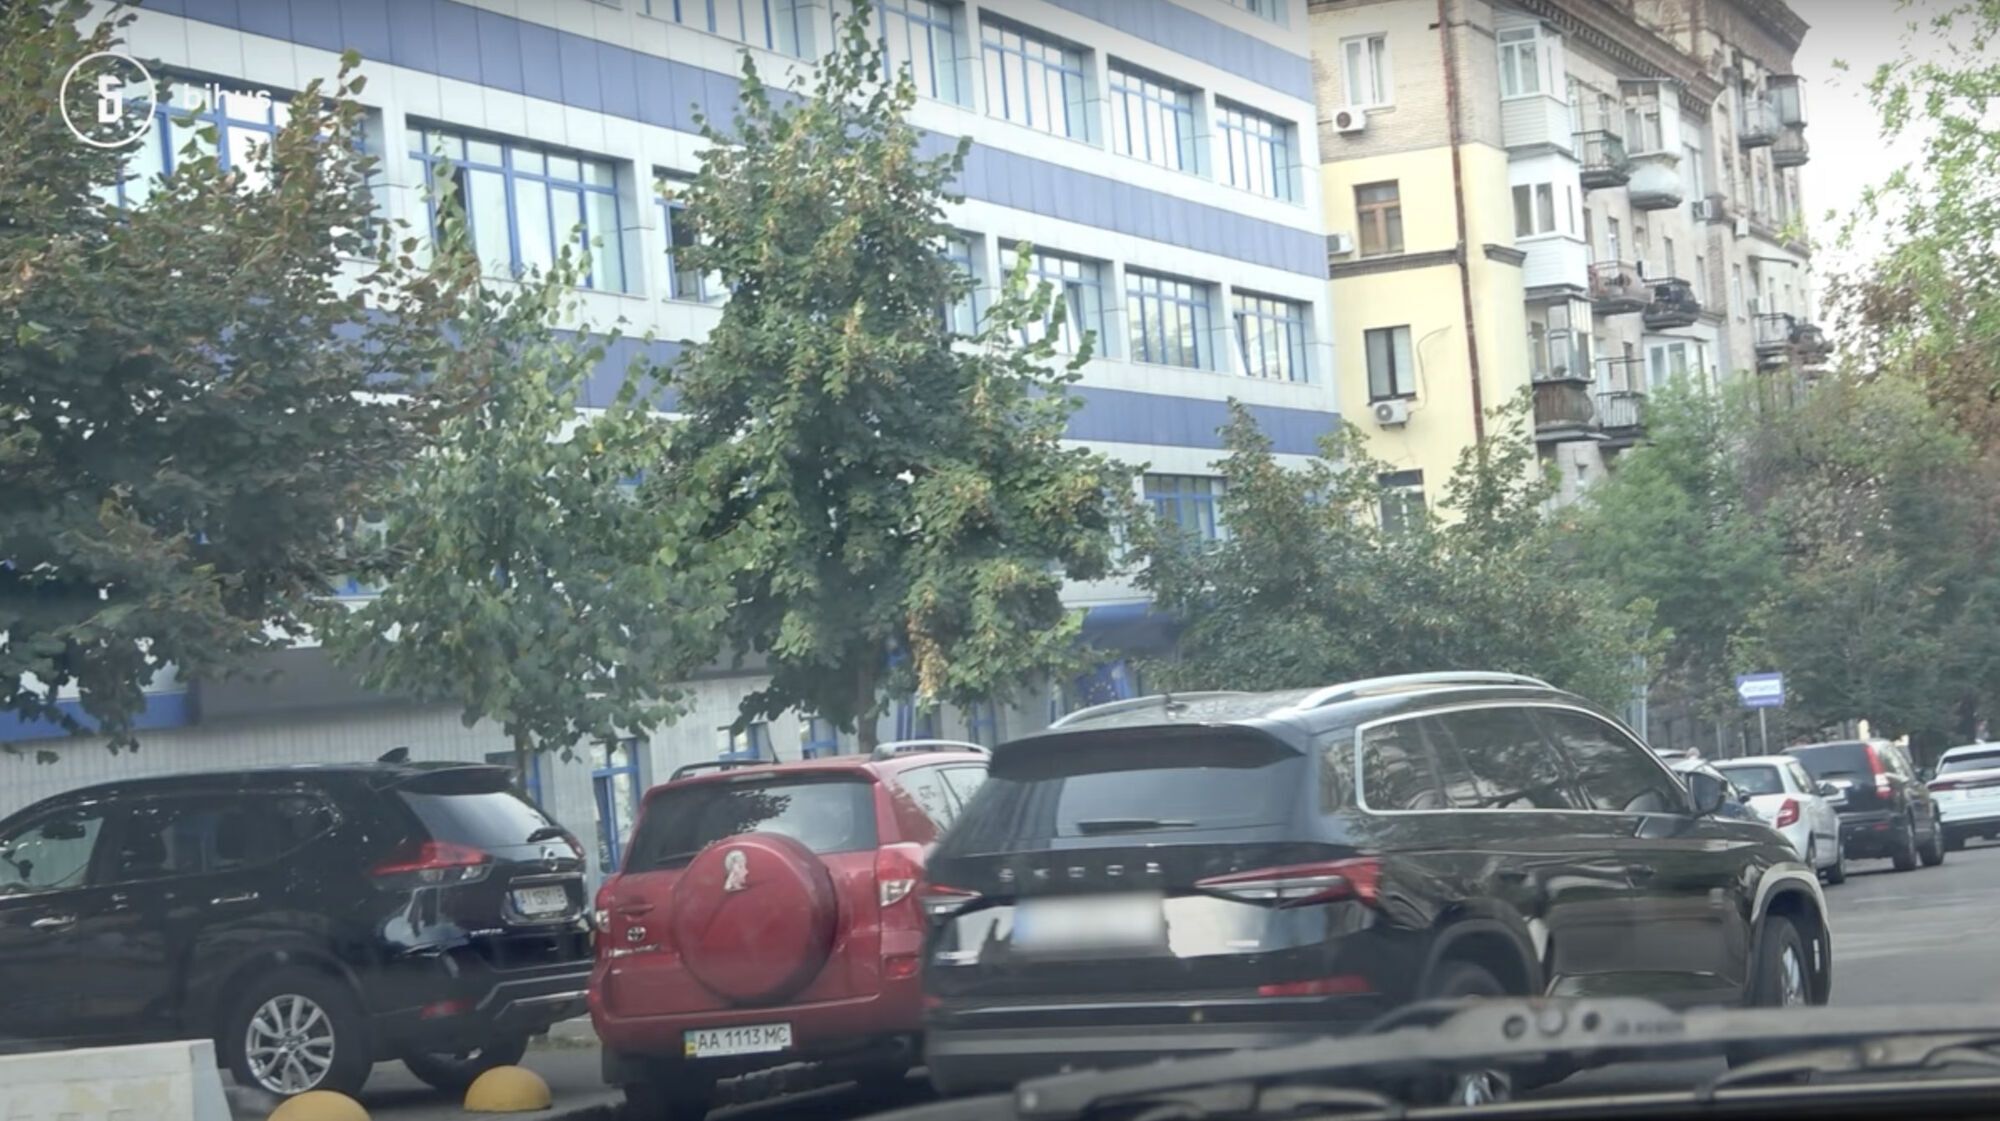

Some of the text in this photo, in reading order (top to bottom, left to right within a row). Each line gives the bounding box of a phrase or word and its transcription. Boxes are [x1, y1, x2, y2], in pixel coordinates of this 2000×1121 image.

[698, 1026, 788, 1050] AA 1113 MC
